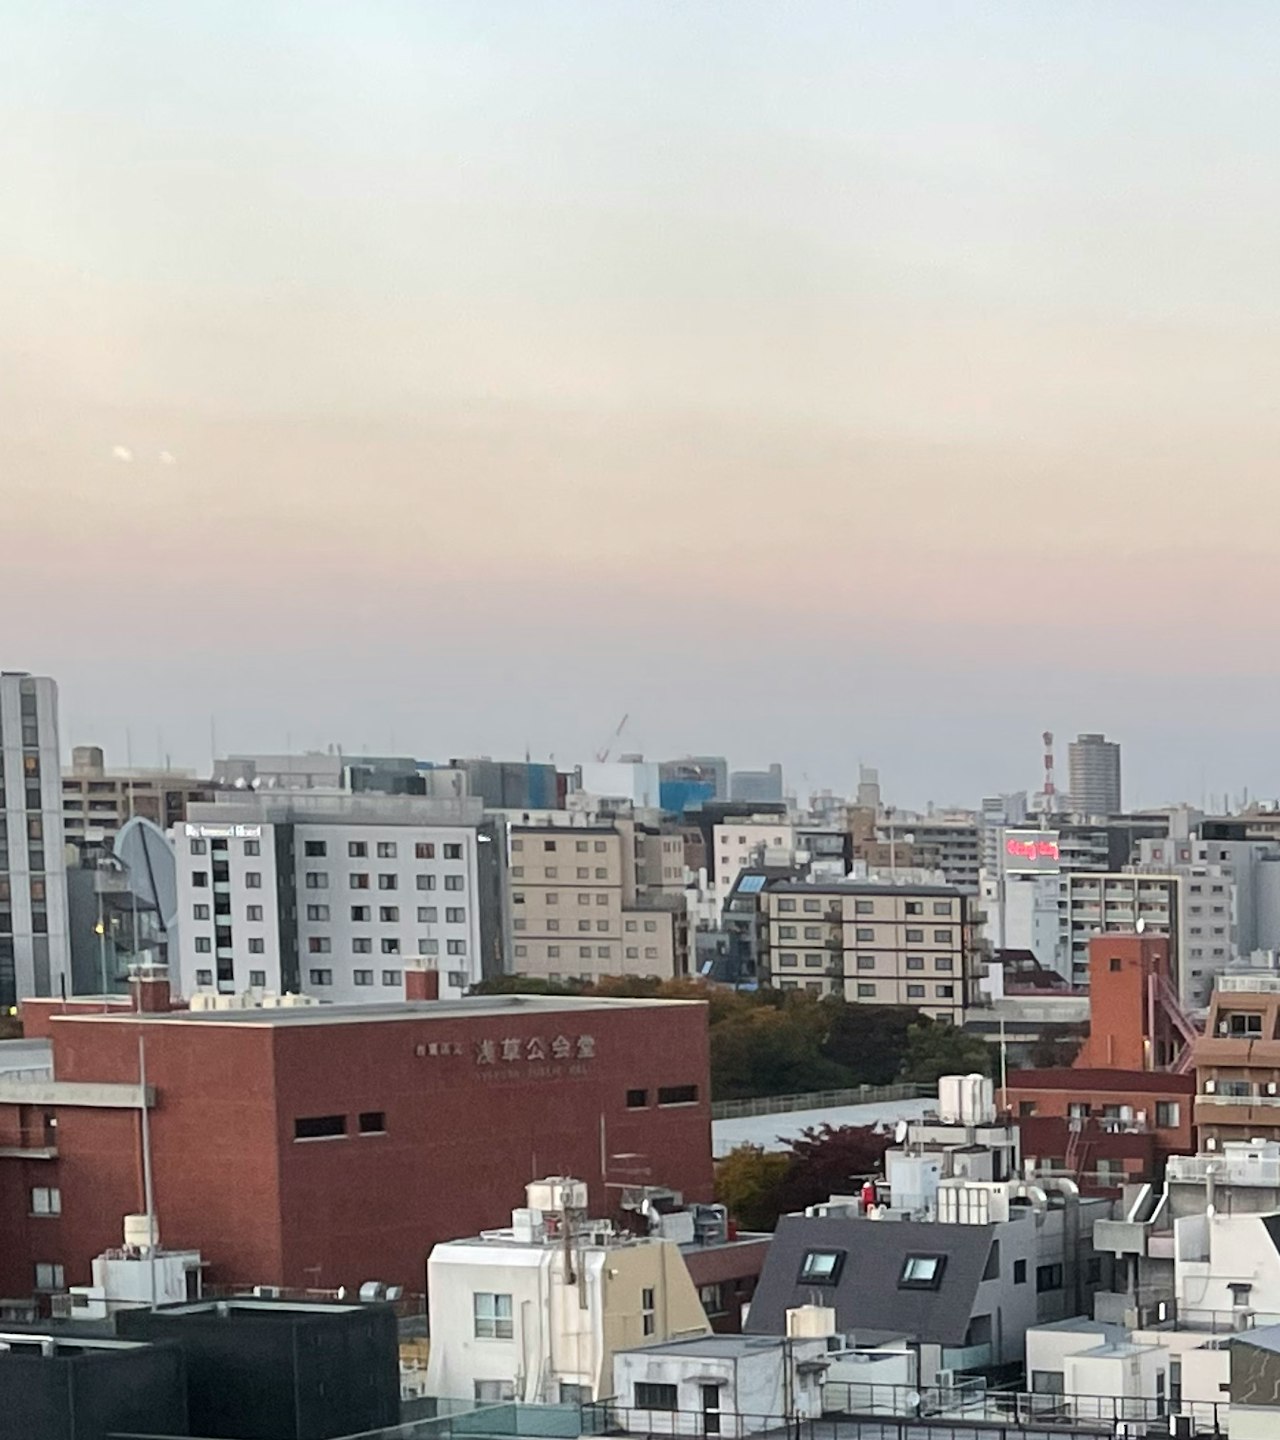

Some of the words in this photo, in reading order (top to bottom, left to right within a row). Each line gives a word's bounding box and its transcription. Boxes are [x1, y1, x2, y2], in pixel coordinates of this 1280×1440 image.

[476, 1034, 596, 1065] 浅草公会堂
